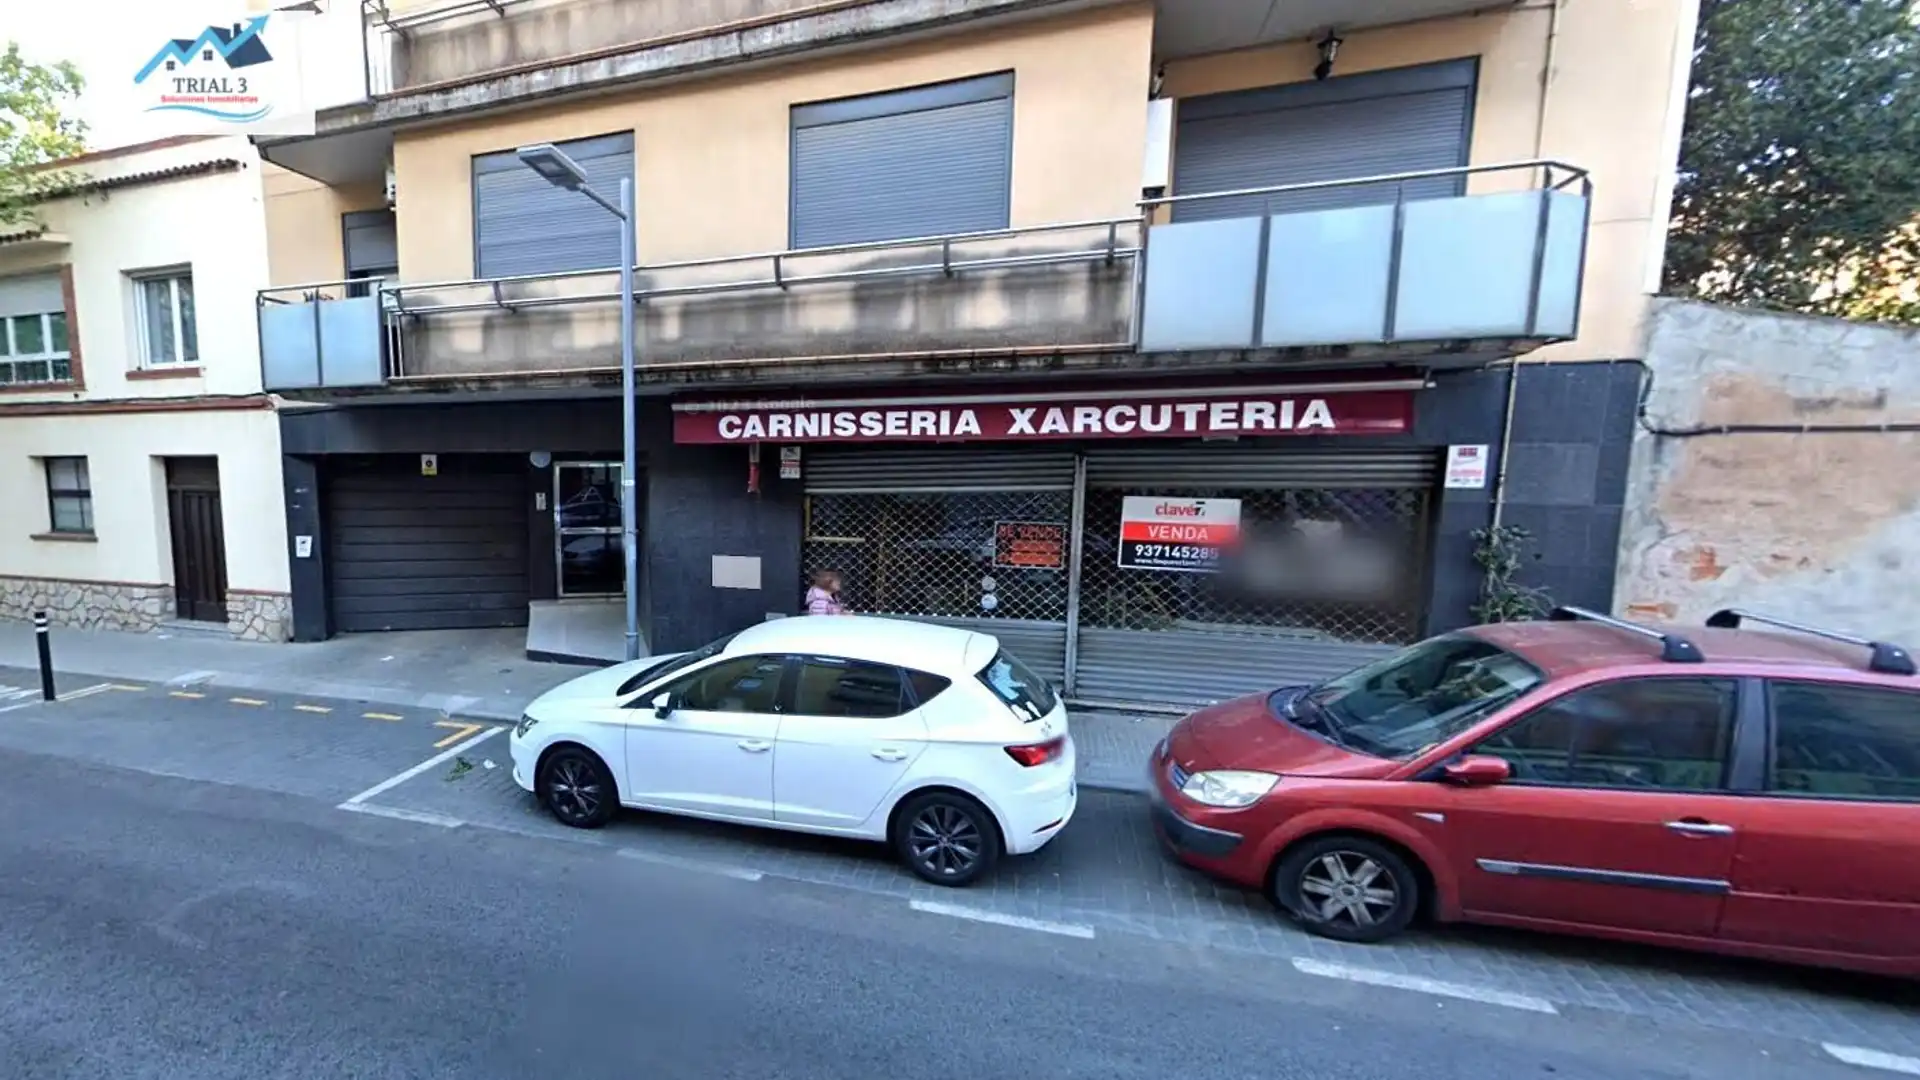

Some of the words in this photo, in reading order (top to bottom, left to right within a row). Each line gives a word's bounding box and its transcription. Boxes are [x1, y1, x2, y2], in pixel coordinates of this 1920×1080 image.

[718, 409, 981, 439] CARNISSERIA
[1007, 399, 1337, 435] XARCUTERIA
[1148, 525, 1208, 540] VENDA
